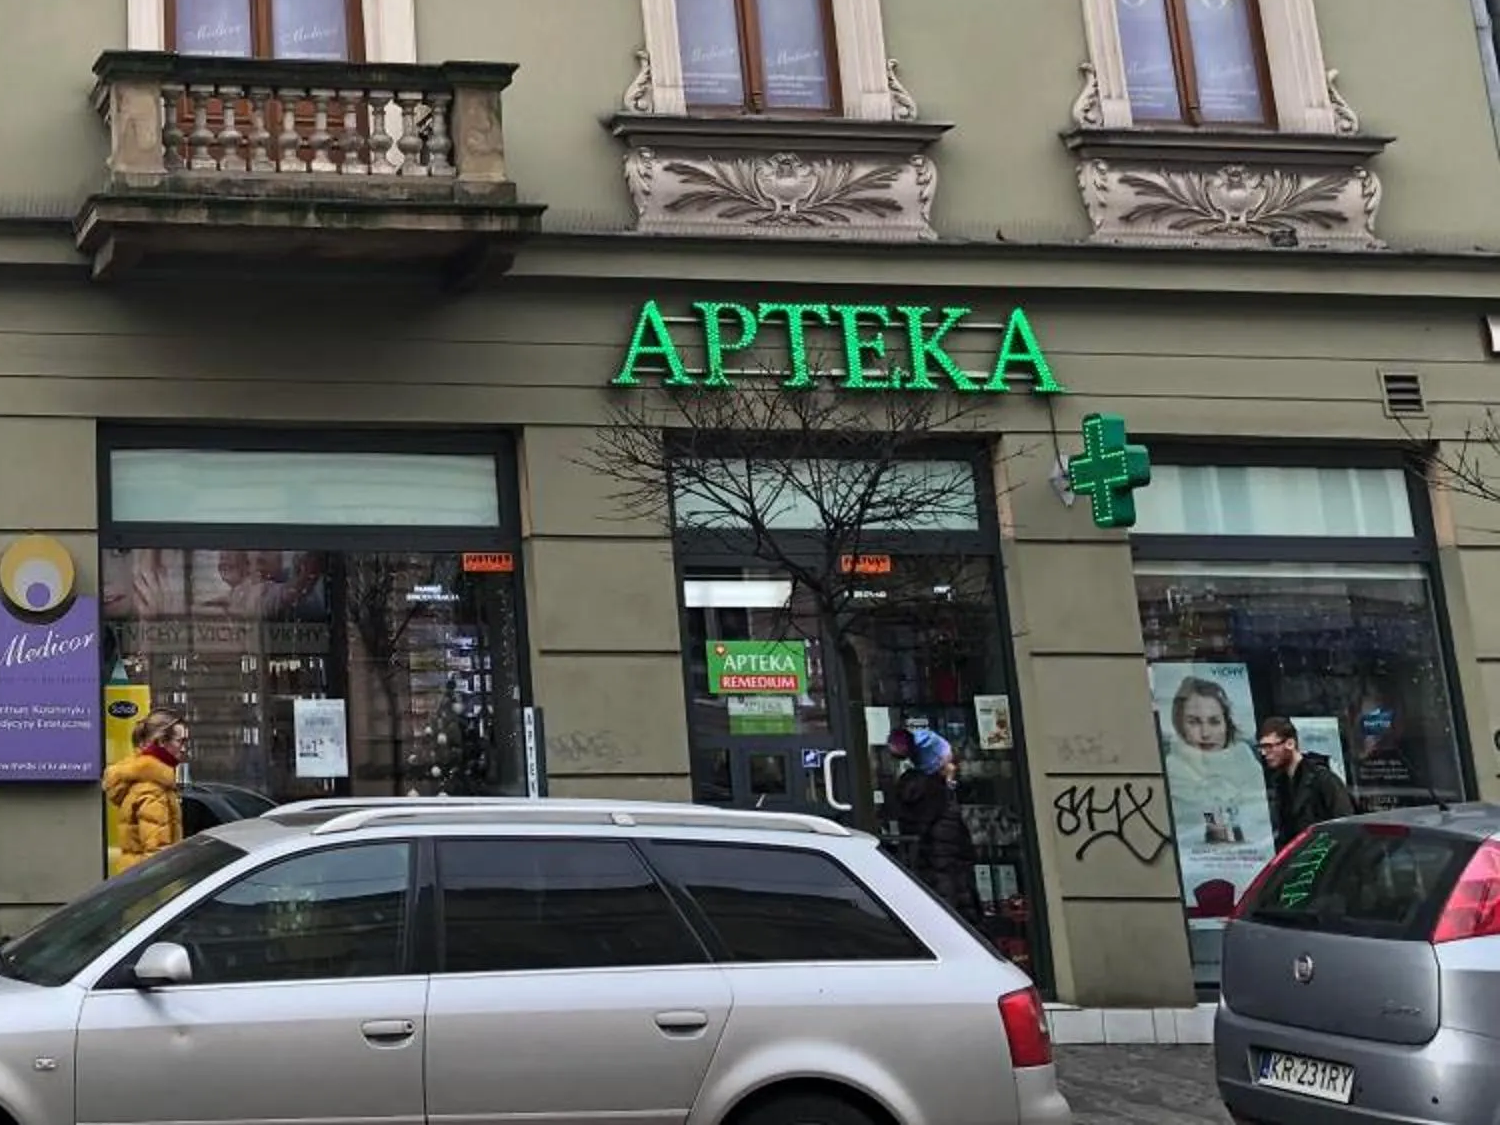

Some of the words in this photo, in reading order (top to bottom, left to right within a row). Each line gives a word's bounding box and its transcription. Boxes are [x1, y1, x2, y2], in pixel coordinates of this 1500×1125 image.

[611, 299, 1066, 394] APTEKA
[723, 654, 797, 672] APTEKA
[722, 675, 796, 689] REMEDIUM
[1271, 1052, 1295, 1083] KR
[1298, 1059, 1355, 1094] 231RY
